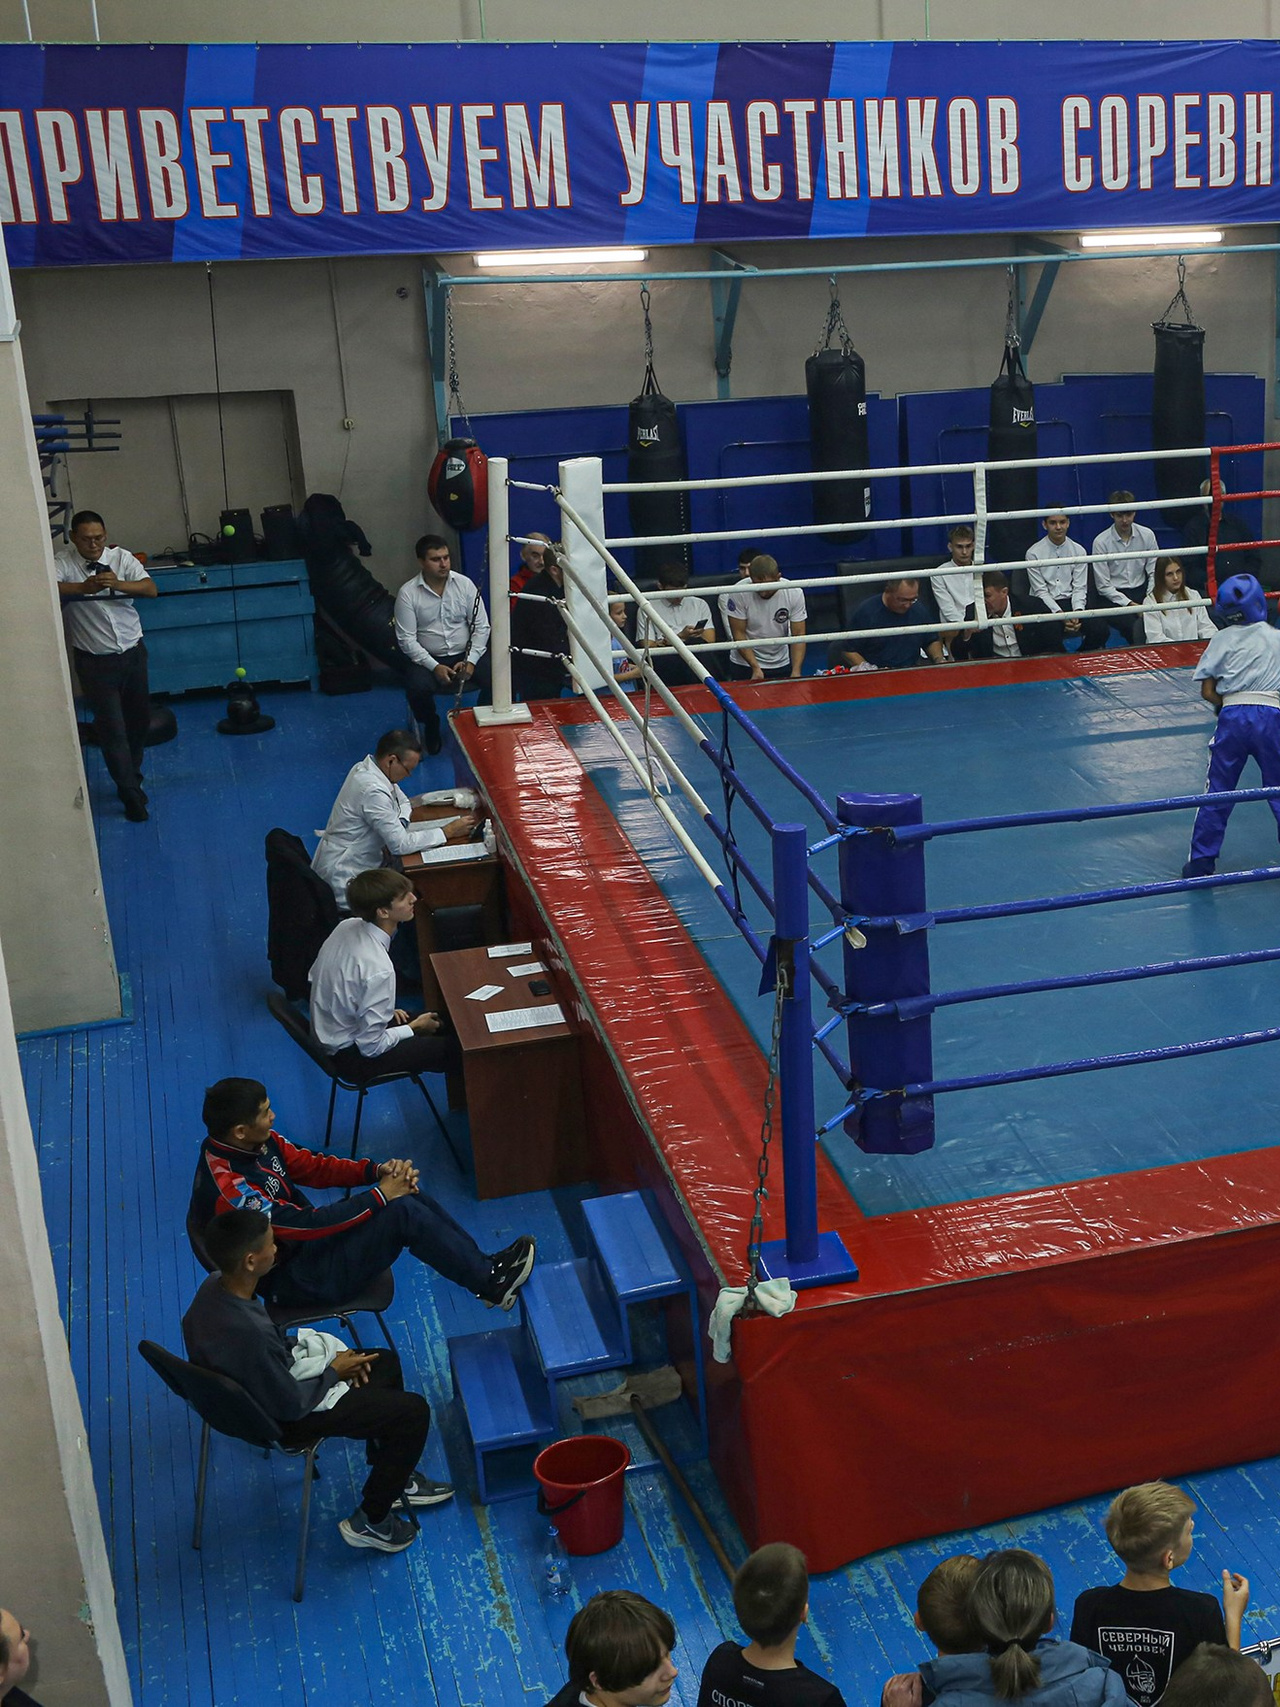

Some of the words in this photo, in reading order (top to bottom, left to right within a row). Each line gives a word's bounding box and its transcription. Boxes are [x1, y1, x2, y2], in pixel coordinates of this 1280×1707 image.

[0, 103, 573, 224] ПРИВЕТСТВУЕМ
[612, 96, 1019, 206] УЧАСТНИКОВ
[1102, 1631, 1170, 1647] СЕВЕРНЫЙ
[1108, 1644, 1165, 1656] ЧЕЛОВЕК
